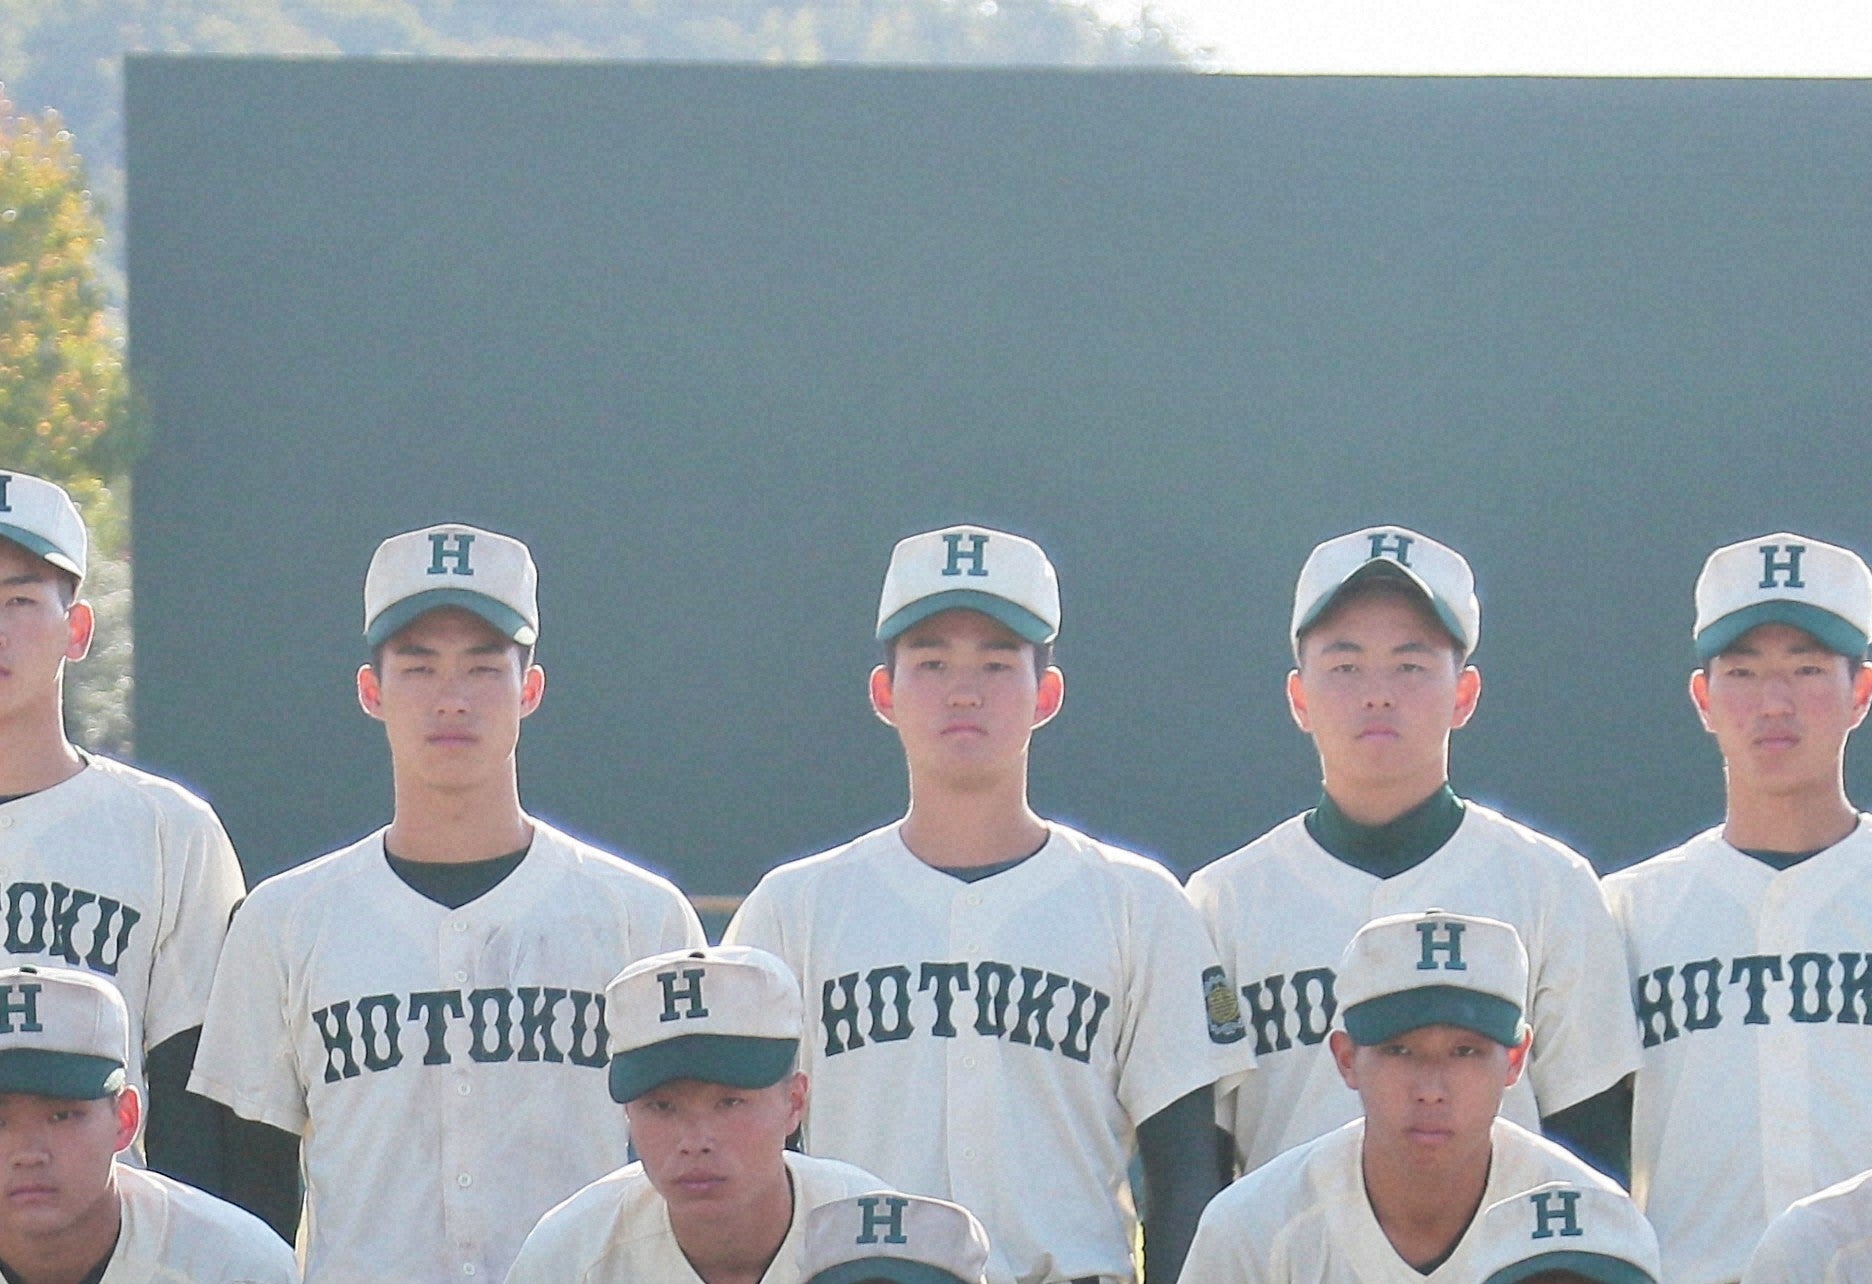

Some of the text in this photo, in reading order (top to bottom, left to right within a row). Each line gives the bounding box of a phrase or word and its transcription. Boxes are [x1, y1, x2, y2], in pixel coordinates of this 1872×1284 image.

[428, 534, 474, 575] H
[941, 534, 989, 576] H
[1367, 534, 1414, 568] H
[1759, 545, 1806, 588] H
[1415, 922, 1467, 971] H
[655, 969, 709, 1022] H
[822, 961, 1110, 1063] HOTOKU
[312, 986, 610, 1083] HOTOKU
[855, 1198, 908, 1245] H
[1530, 1191, 1583, 1238] H
